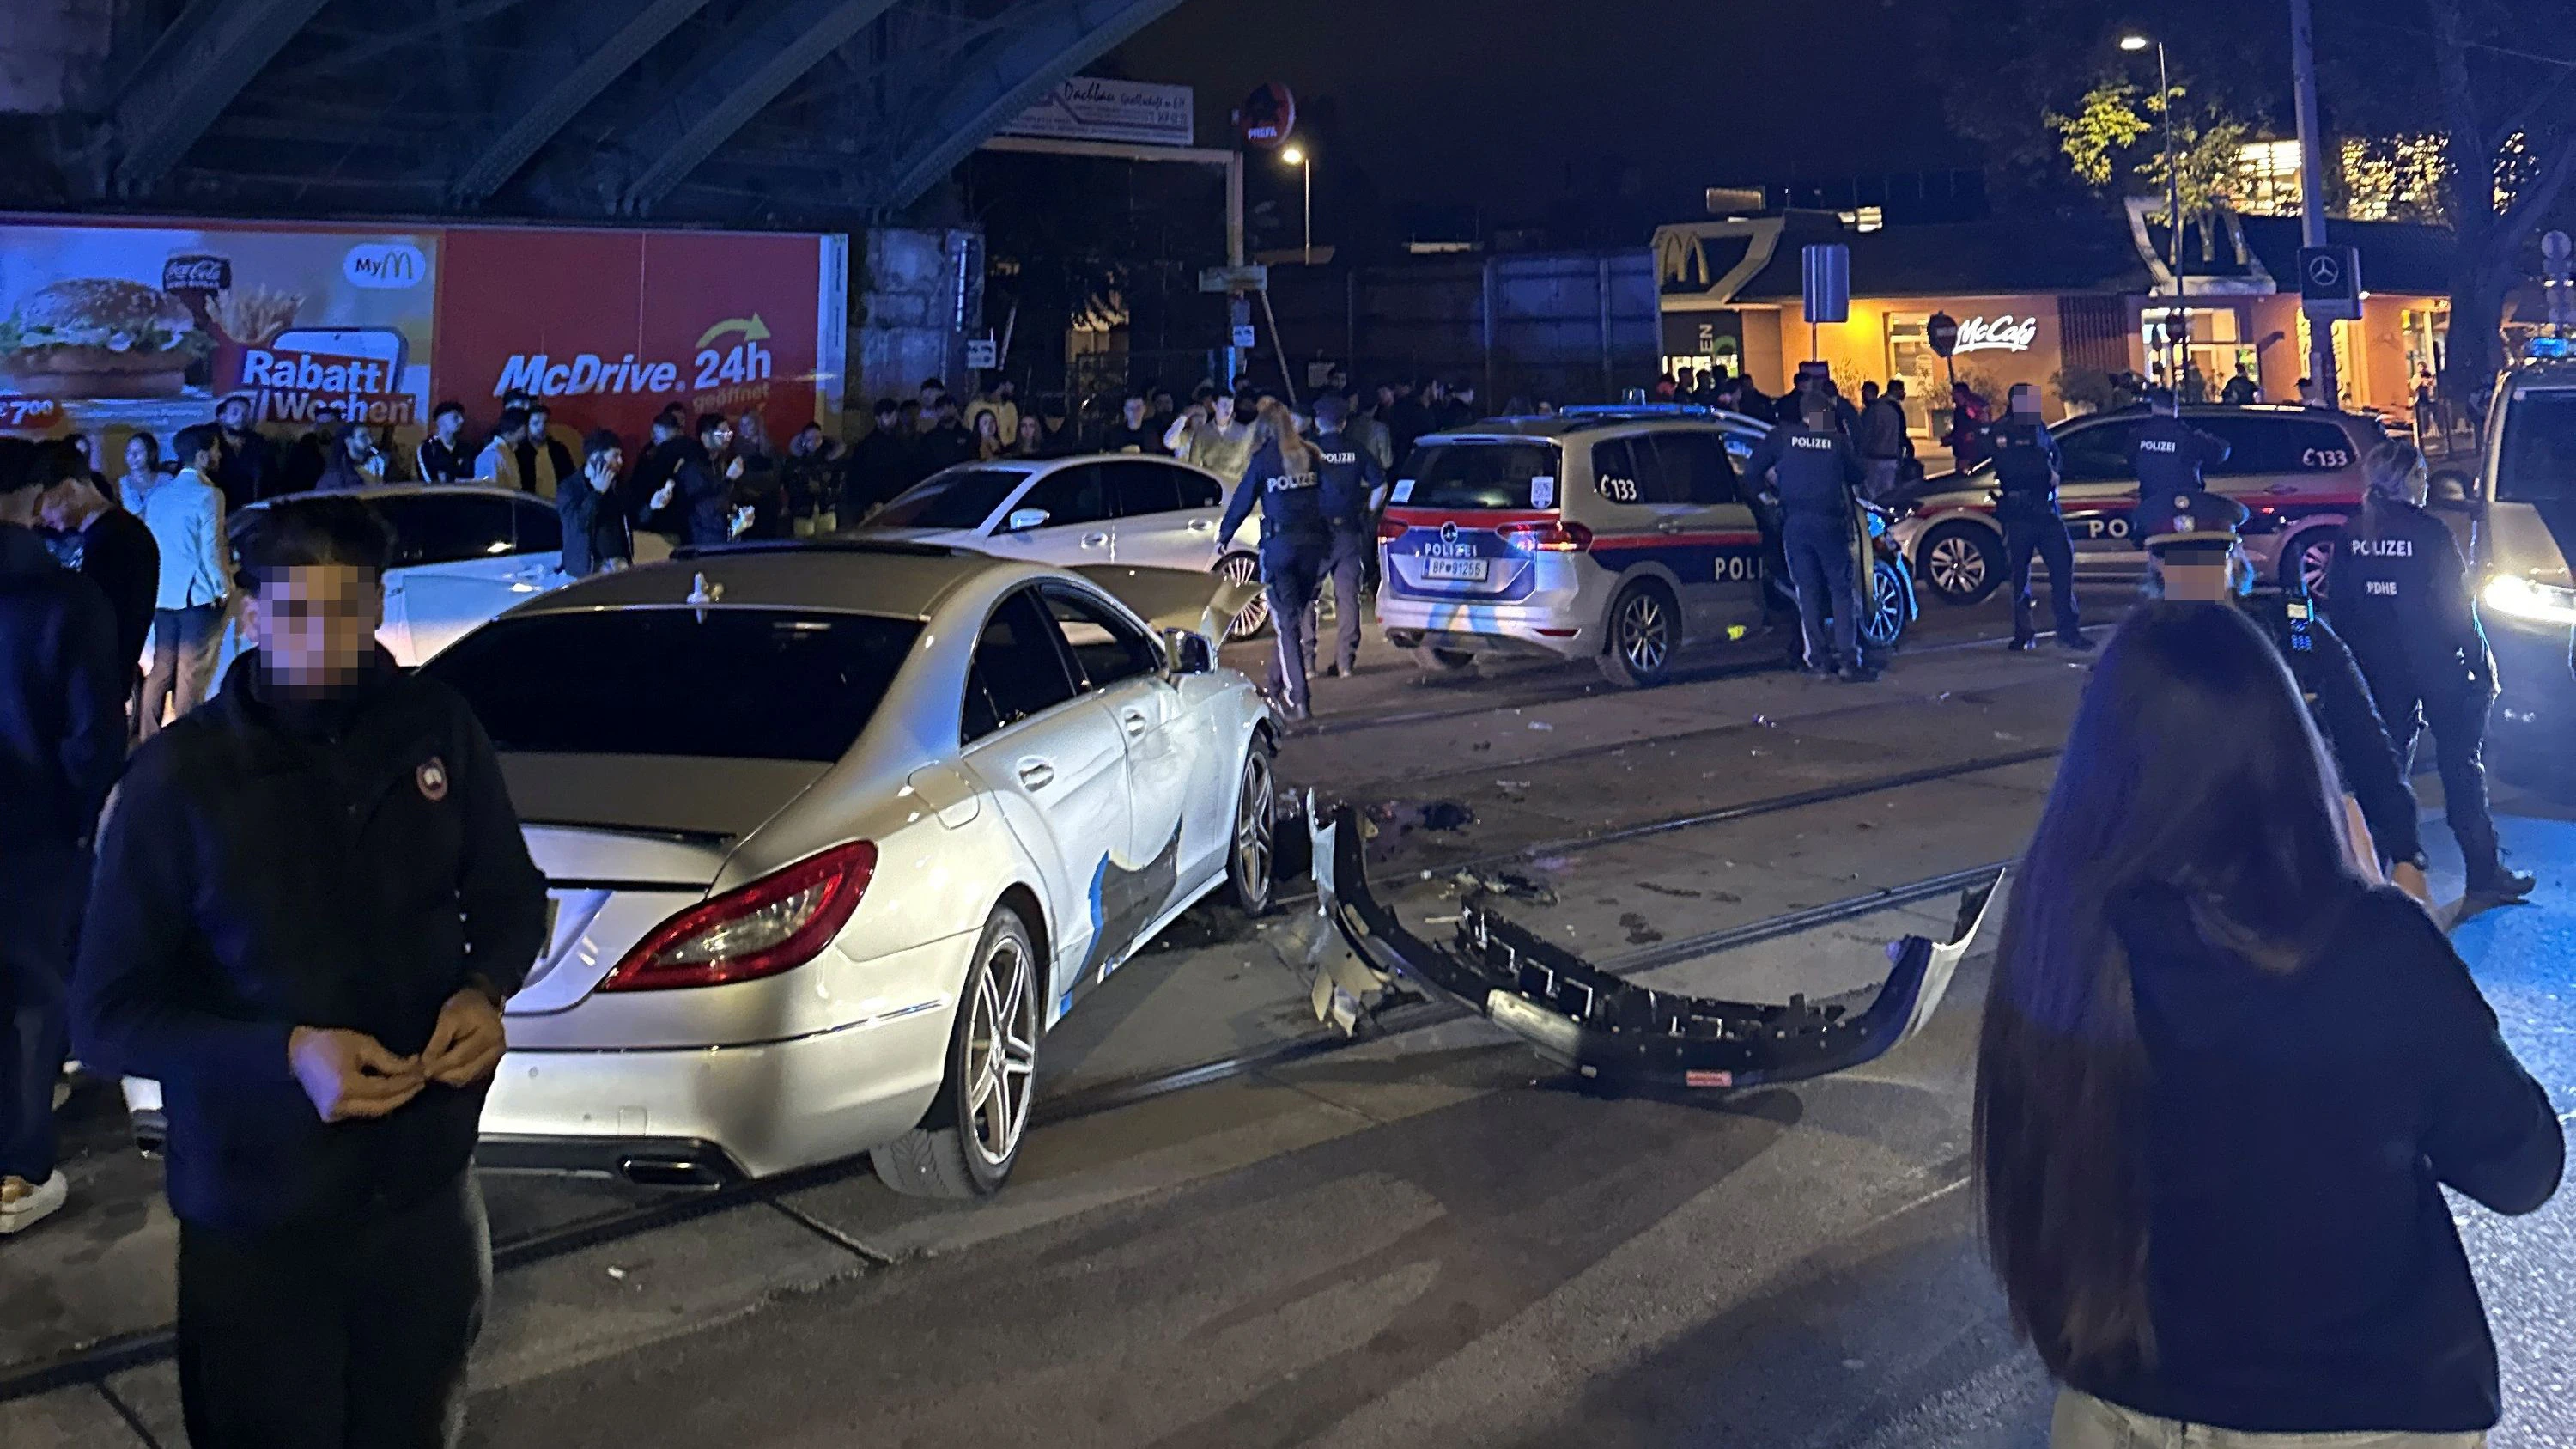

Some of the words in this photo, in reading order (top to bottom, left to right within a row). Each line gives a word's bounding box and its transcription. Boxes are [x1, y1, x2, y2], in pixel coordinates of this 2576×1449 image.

[243, 350, 382, 393] Rabatt
[694, 341, 771, 390] 24h
[1792, 436, 1832, 449] POLIZEI
[2140, 440, 2176, 453] POLIZEI
[2316, 450, 2348, 466] 133
[1267, 472, 1317, 493] POLIZE
[1611, 478, 1637, 501] 133
[2352, 539, 2412, 557] POLIZEI
